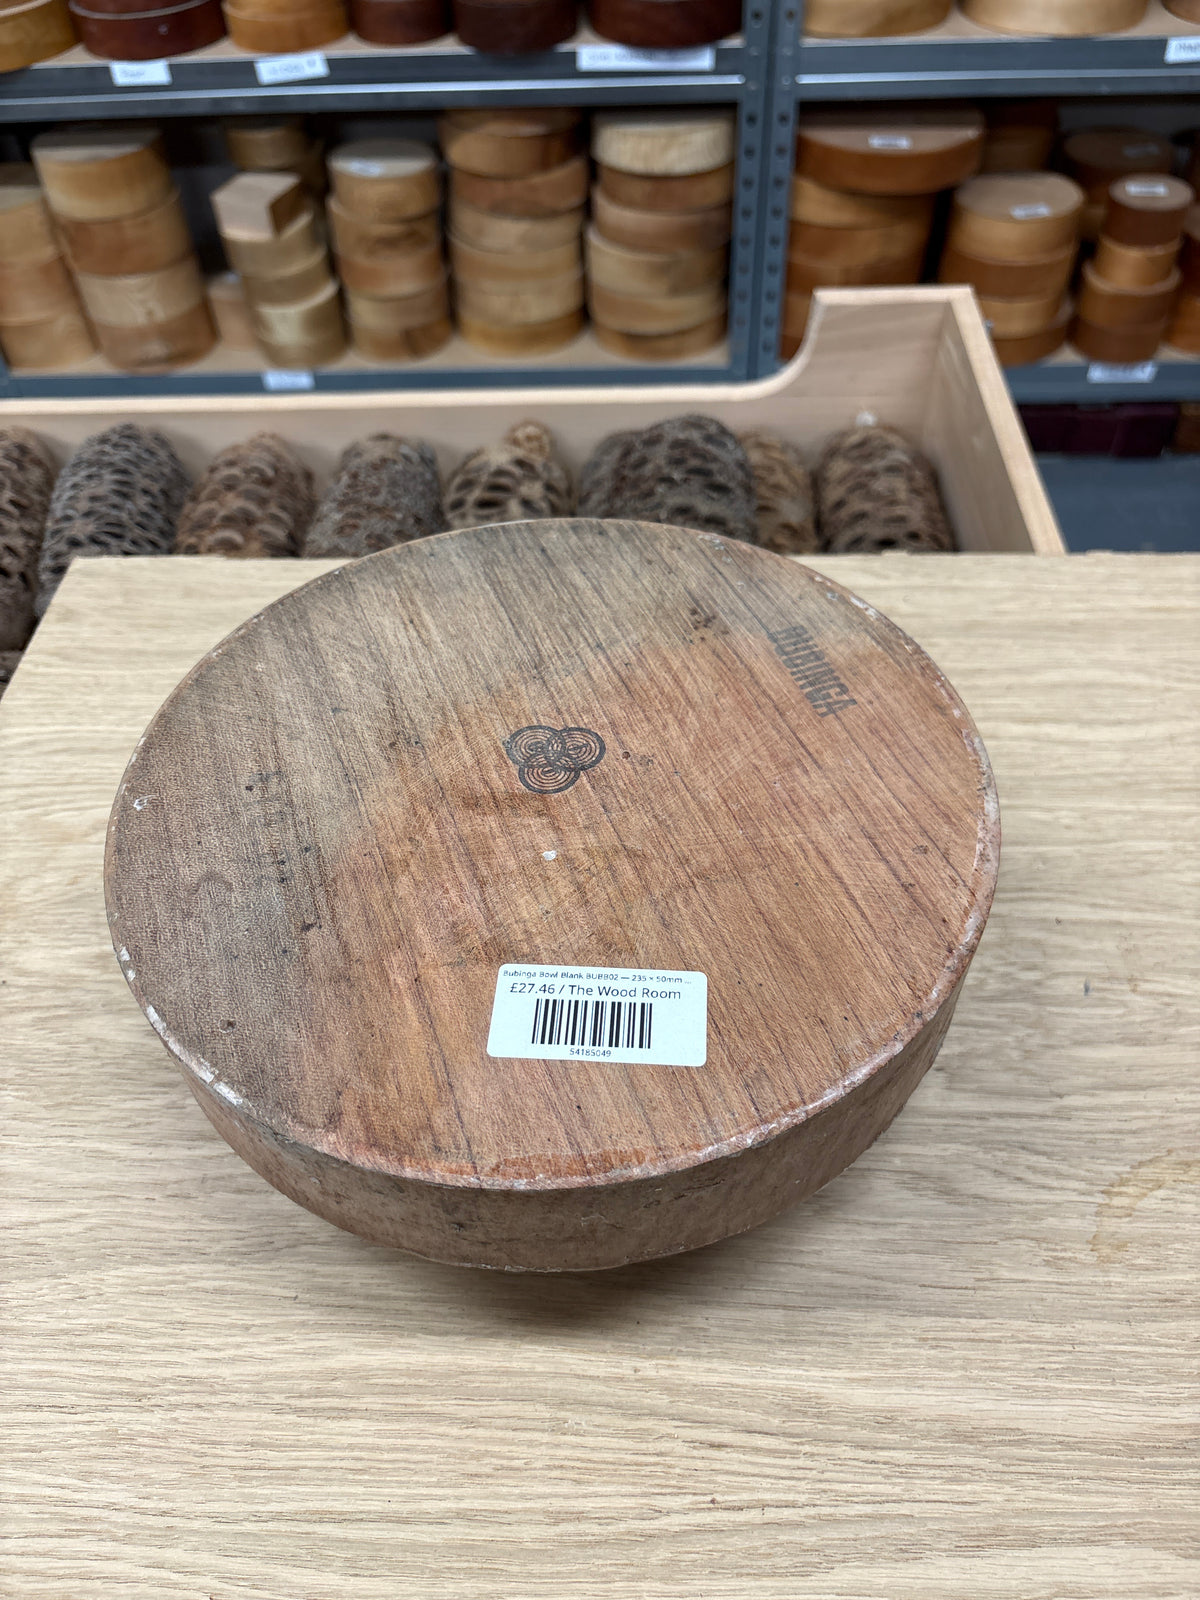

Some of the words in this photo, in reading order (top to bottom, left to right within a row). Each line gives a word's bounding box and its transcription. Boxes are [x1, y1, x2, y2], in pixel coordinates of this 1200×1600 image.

[767, 625, 858, 718] BUBINGA
[503, 970, 537, 978] Bubinga
[539, 970, 558, 978] Bowl
[561, 971, 583, 979] Blank
[631, 974, 647, 982] 235
[510, 982, 555, 994] £27.46
[558, 984, 565, 994] /
[568, 984, 594, 996] The
[597, 986, 637, 998] Wood
[641, 987, 681, 999] Room
[569, 1047, 612, 1057] 54185049
